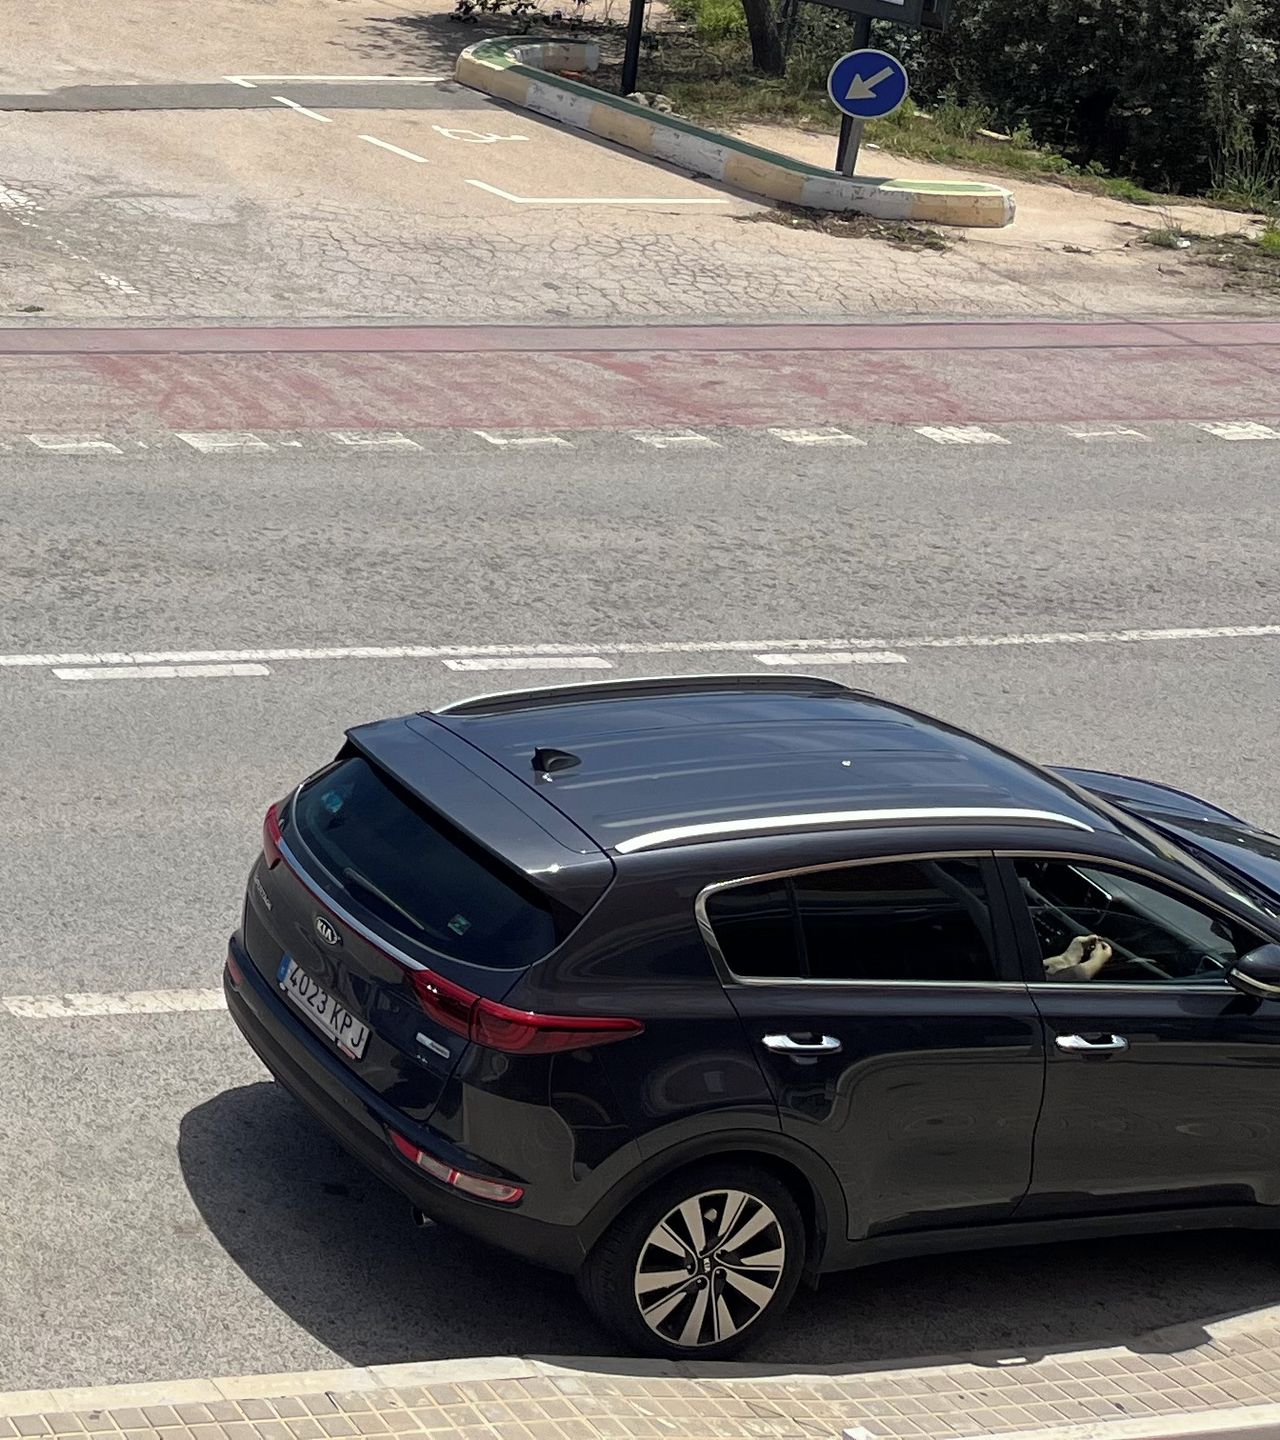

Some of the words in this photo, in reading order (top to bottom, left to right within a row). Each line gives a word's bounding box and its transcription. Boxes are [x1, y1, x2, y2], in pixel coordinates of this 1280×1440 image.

[316, 918, 337, 941] KIA
[289, 966, 329, 1016] 4023
[329, 1006, 366, 1048] KPJ
